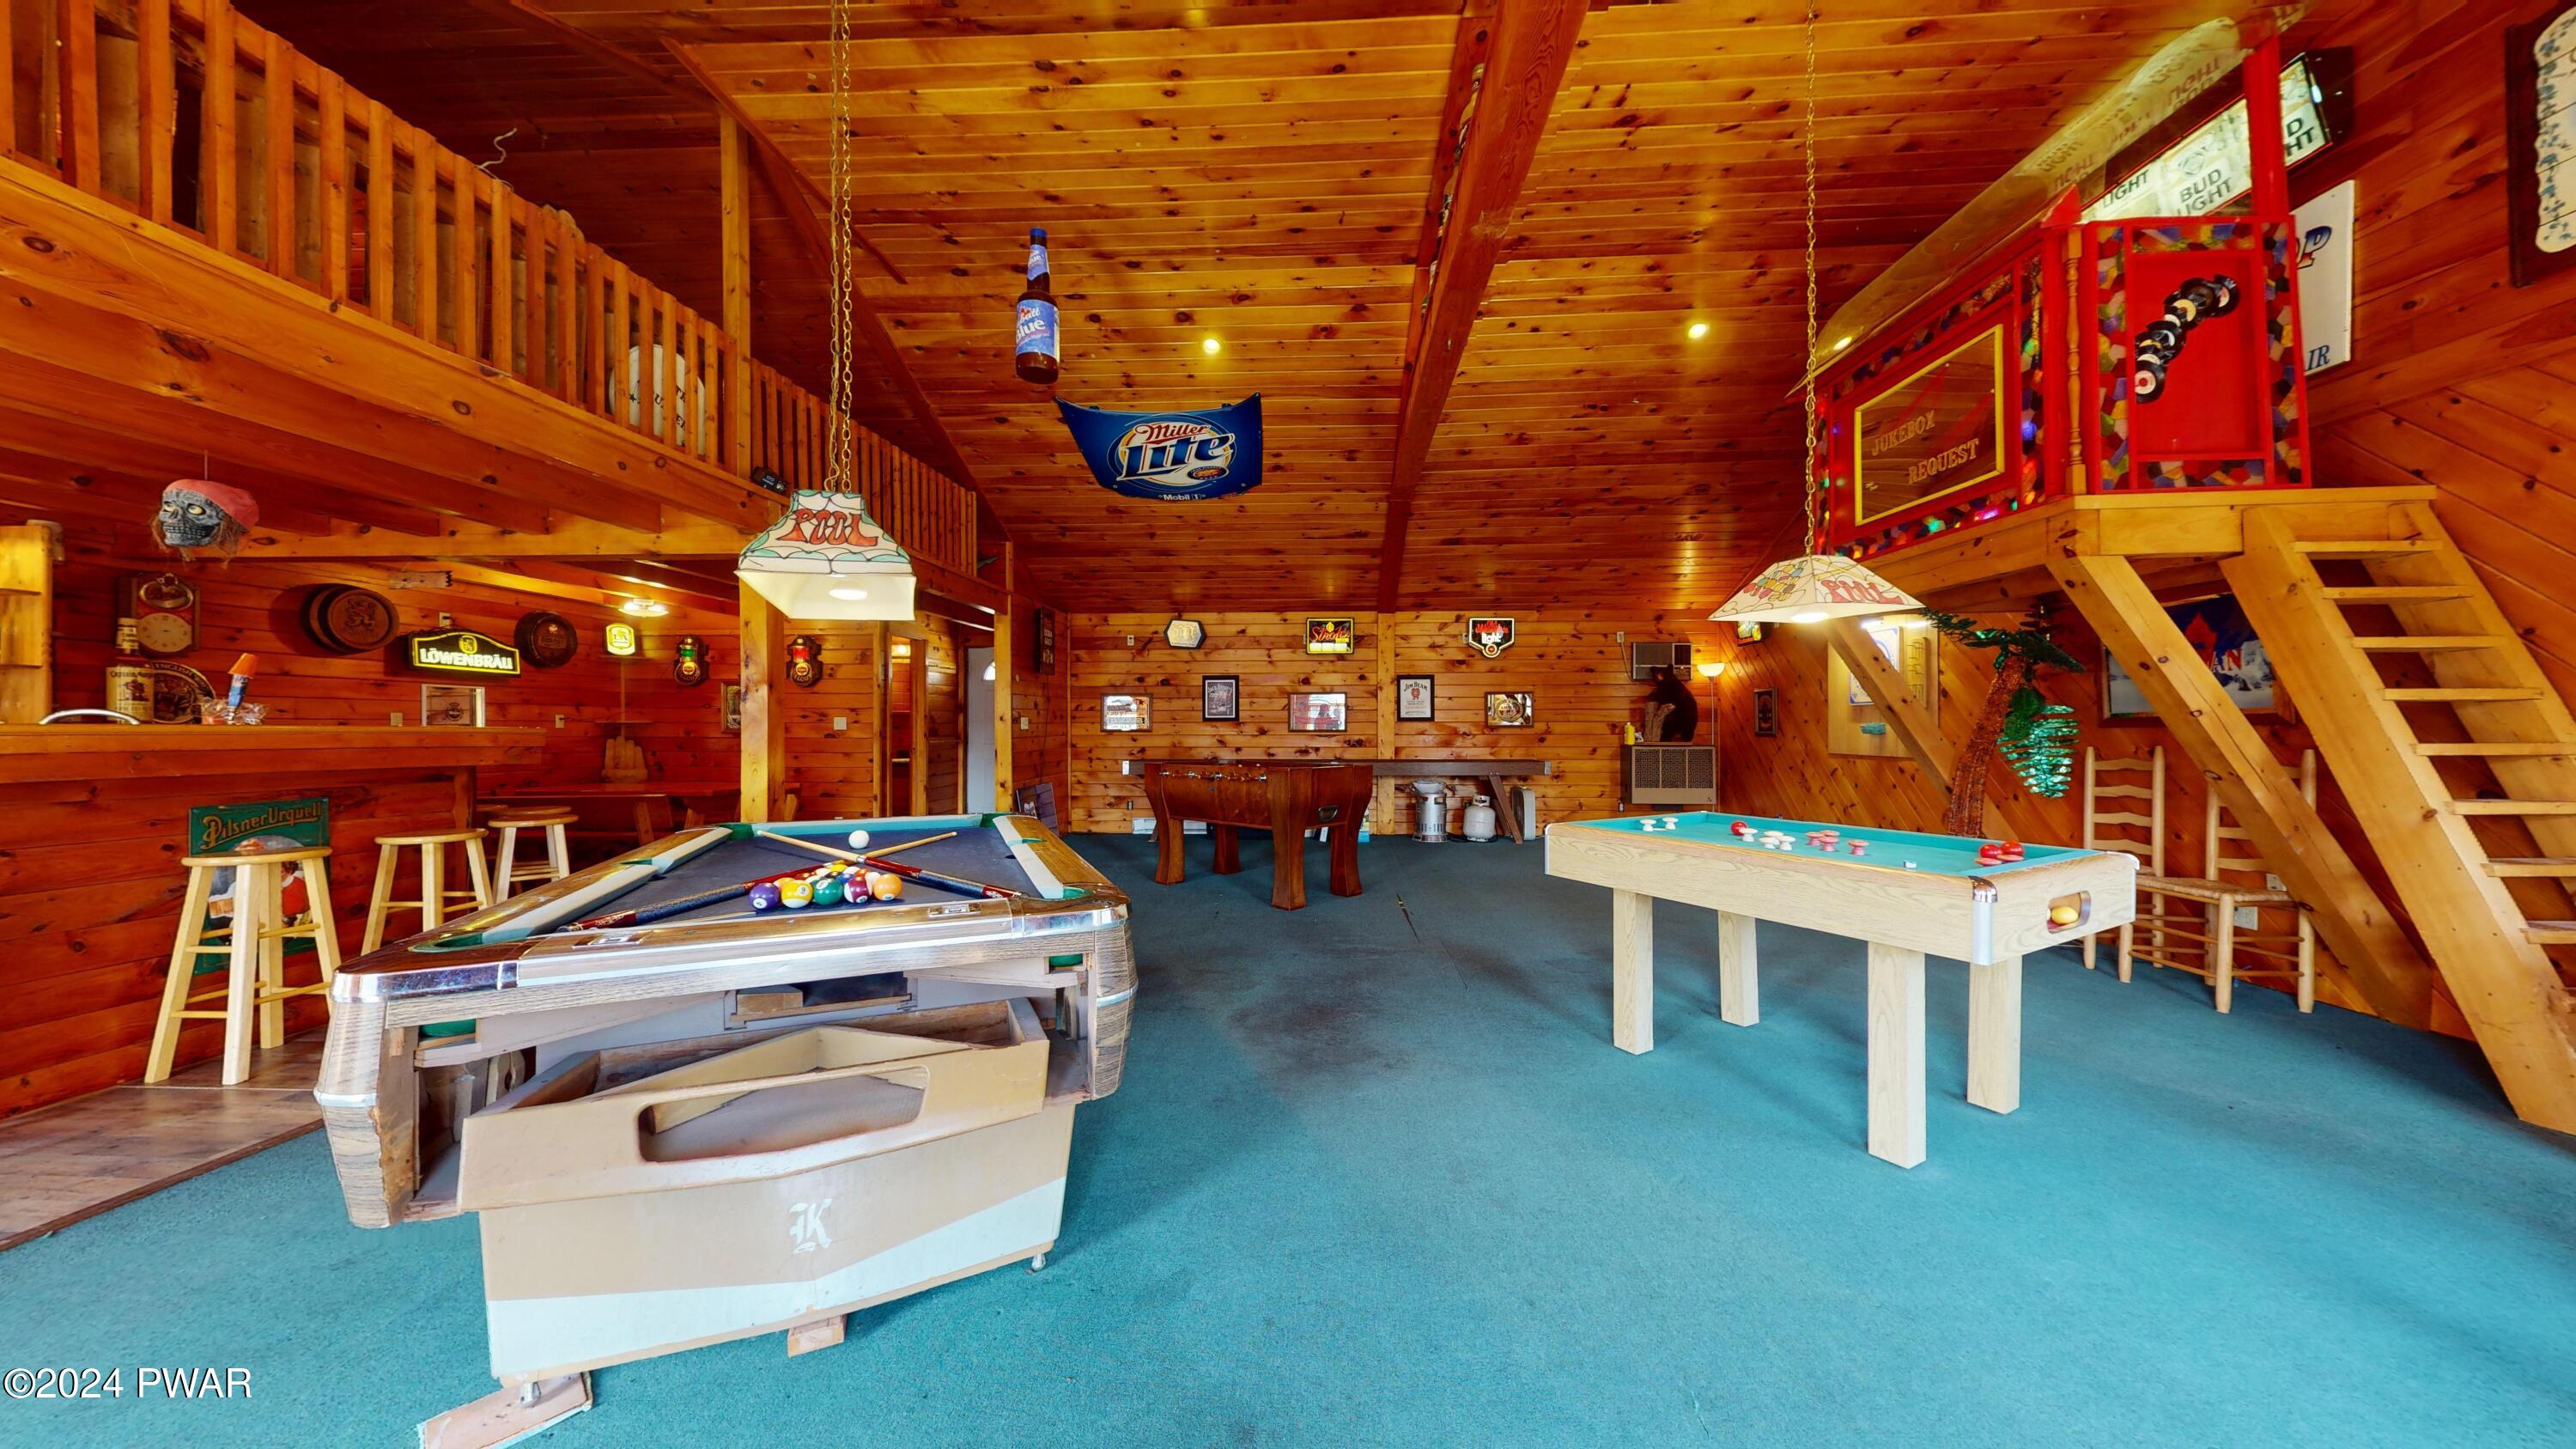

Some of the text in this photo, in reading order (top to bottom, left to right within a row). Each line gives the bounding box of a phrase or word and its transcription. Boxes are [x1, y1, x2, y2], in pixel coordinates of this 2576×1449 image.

[2180, 168, 2222, 204] BUD
[1134, 423, 1212, 446] Miller
[1871, 409, 1936, 457] JUKEBOX
[1116, 433, 1236, 481] Lite
[1908, 438, 1979, 484] REQUEST
[419, 648, 513, 670] LÖWENBRÄU
[200, 802, 322, 850] Pilsner Urquell
